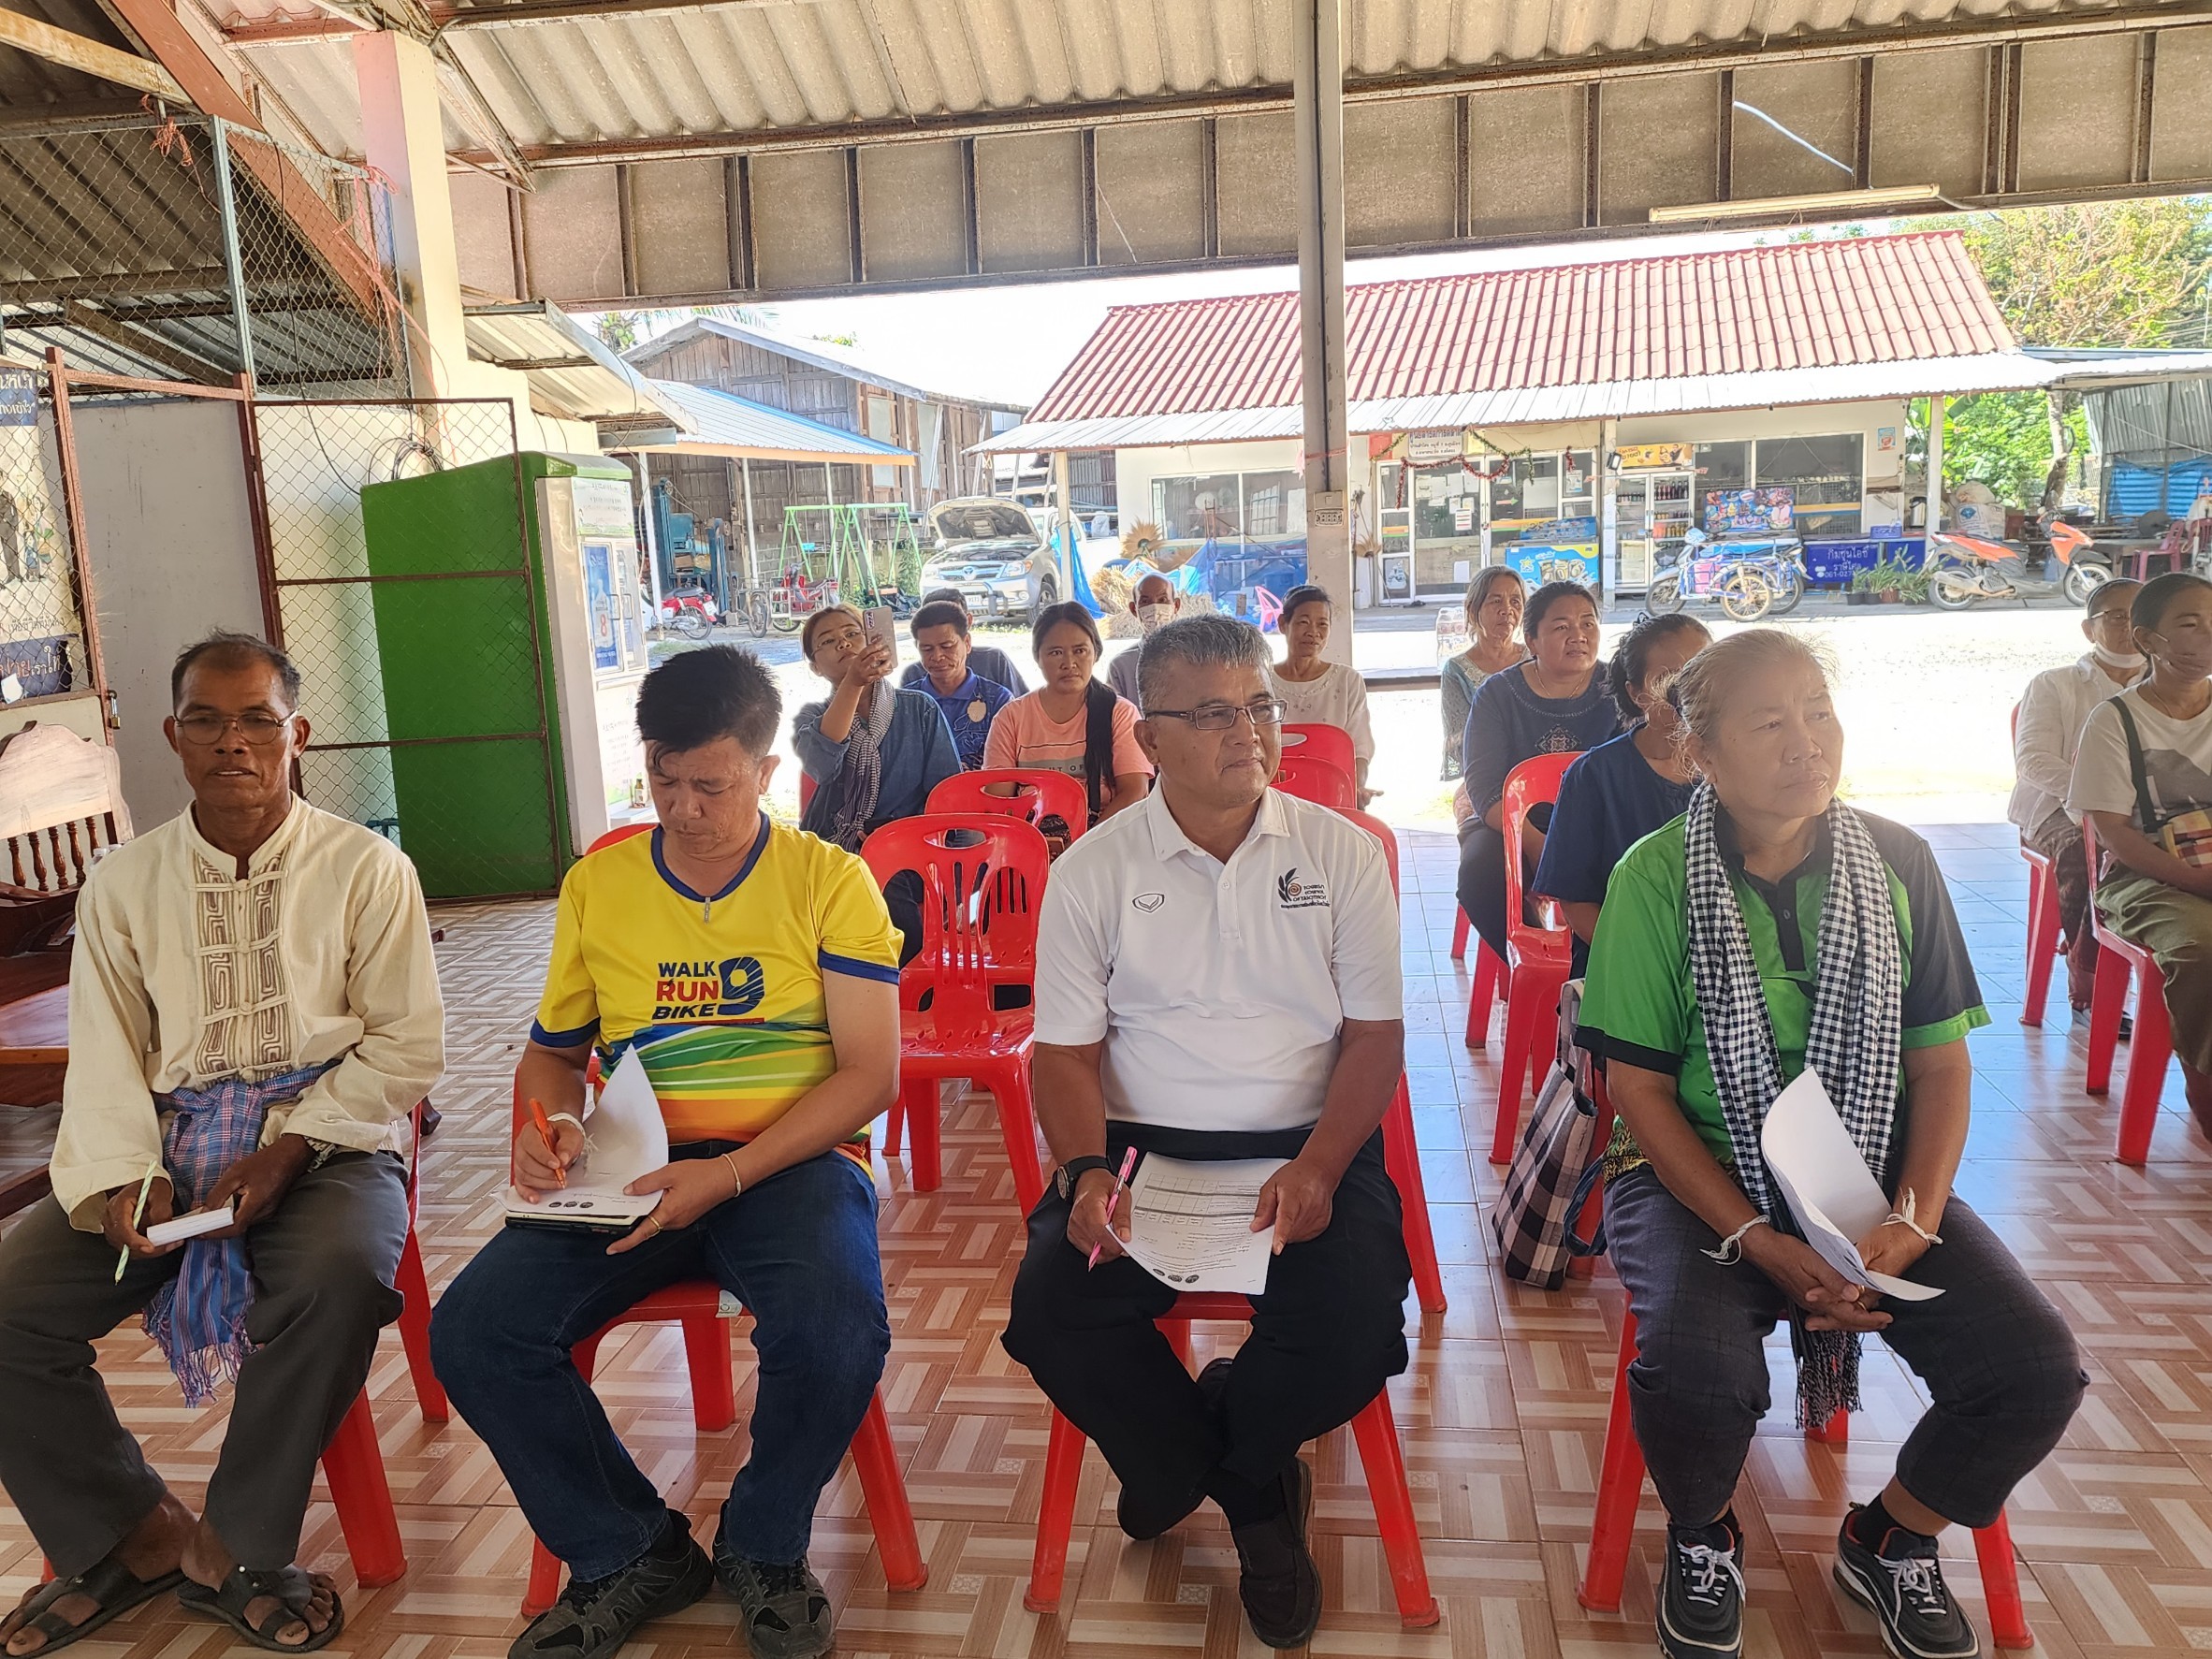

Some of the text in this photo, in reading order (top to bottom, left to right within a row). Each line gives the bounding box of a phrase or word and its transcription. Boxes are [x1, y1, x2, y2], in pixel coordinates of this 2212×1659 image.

[658, 961, 717, 978] WALK
[656, 980, 719, 1002] RUN
[652, 1003, 717, 1020] BIKE
